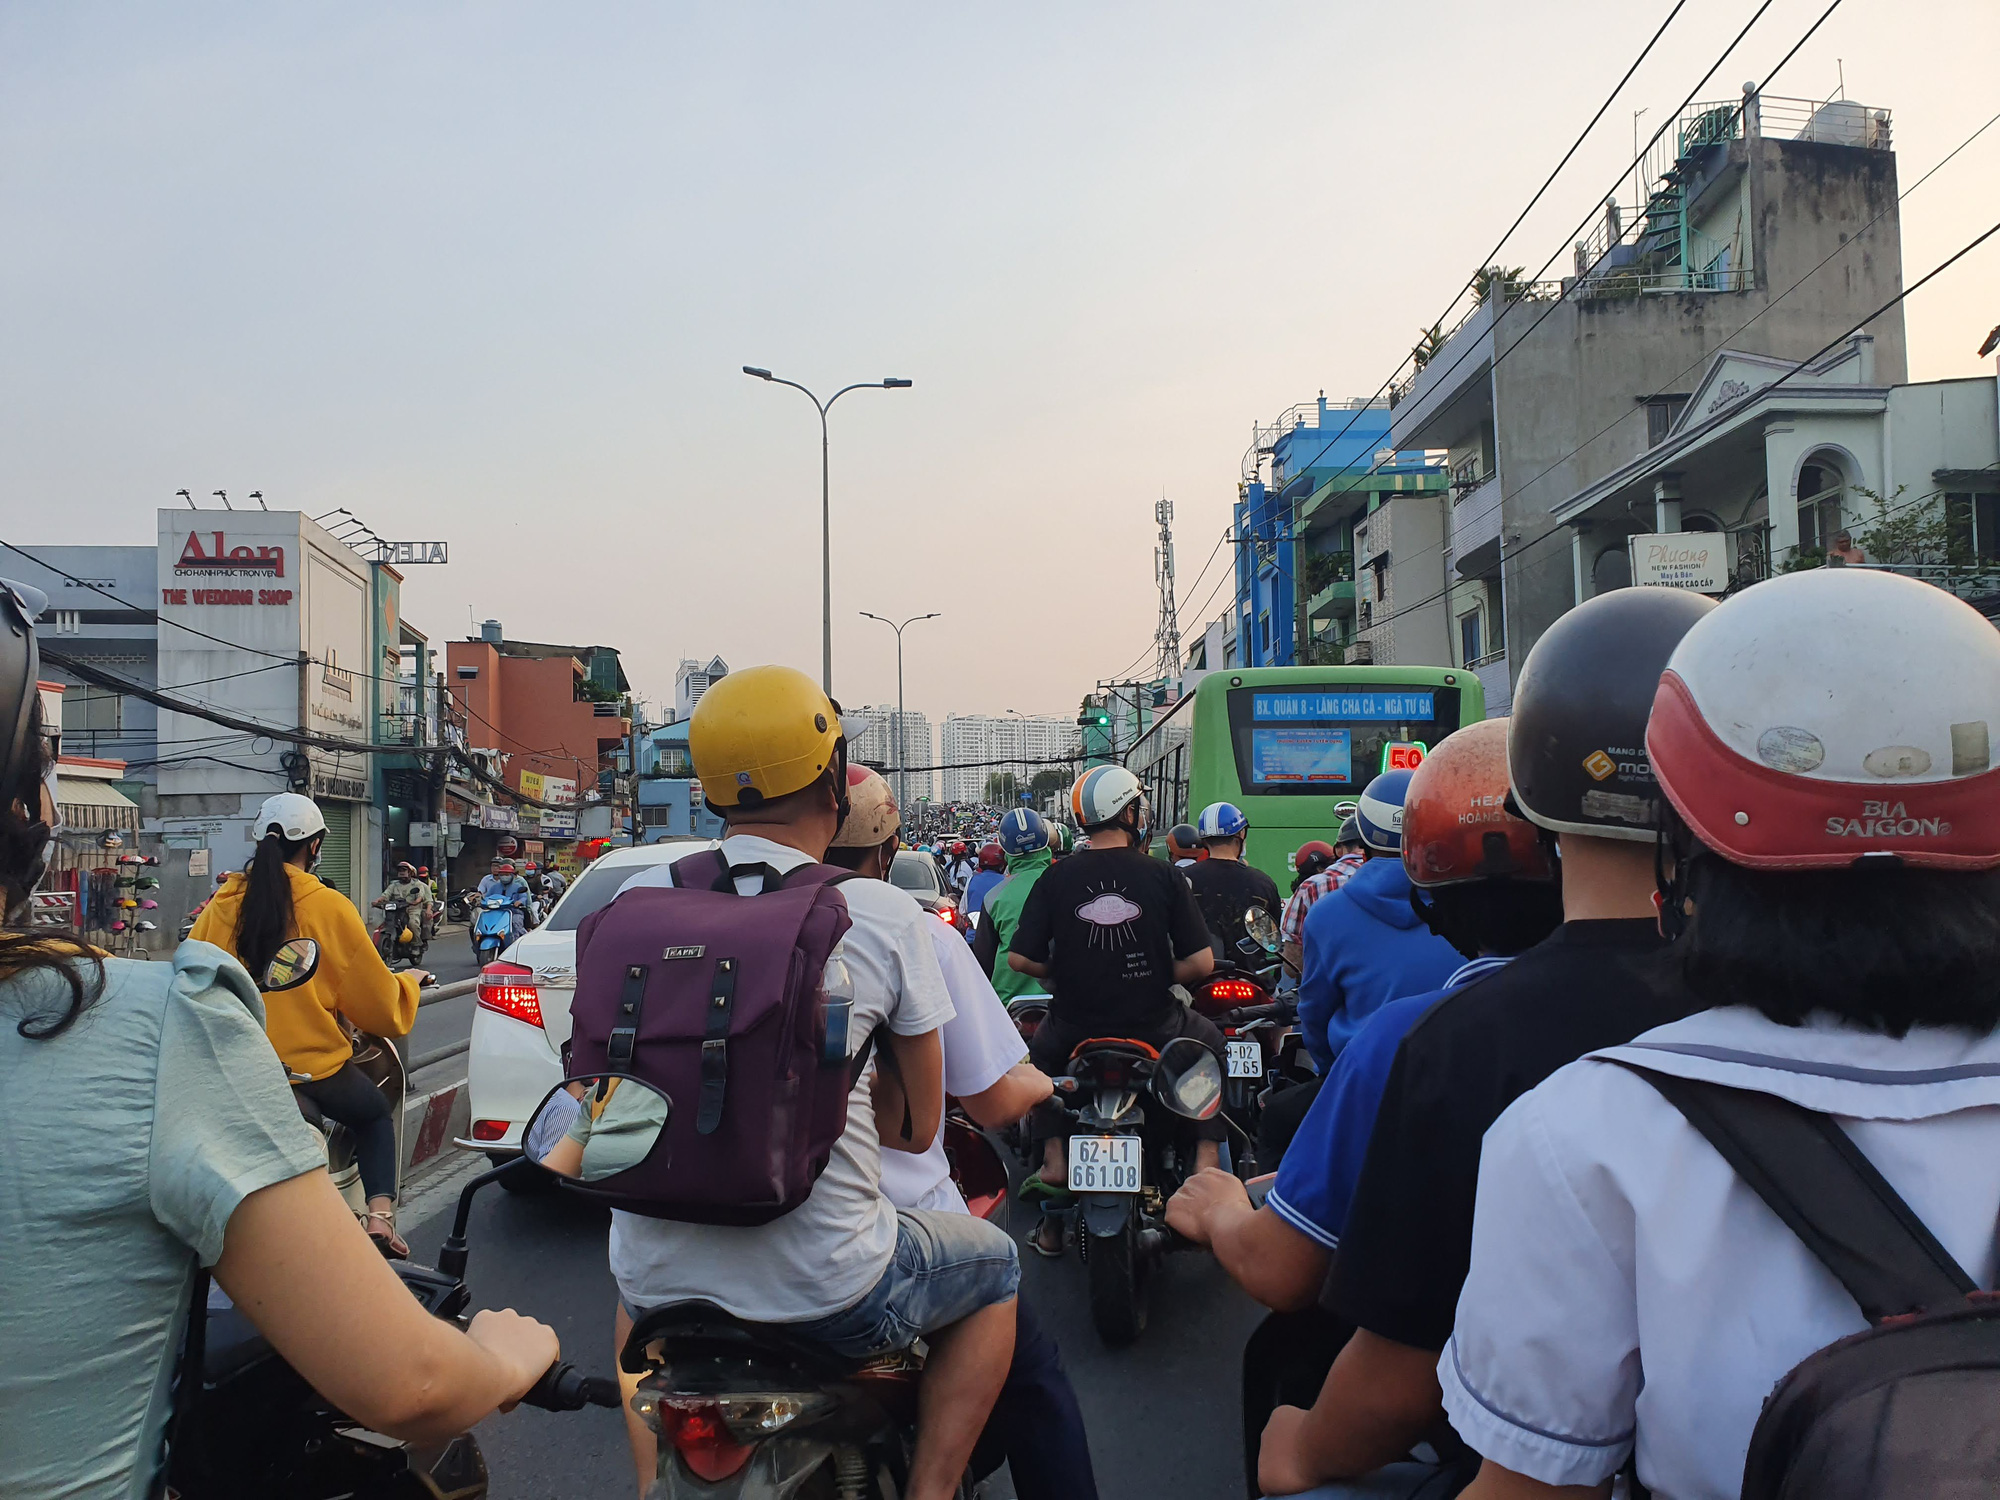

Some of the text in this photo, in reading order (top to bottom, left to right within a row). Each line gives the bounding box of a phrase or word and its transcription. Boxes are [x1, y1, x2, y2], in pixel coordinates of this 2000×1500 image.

[1661, 580, 1684, 588] TRANG
[1685, 580, 1699, 588] CAO
[162, 589, 292, 605] THE WEDDING SHOP
[1256, 700, 1271, 715] BX.
[1273, 696, 1298, 718] QUẬN
[1301, 700, 1306, 714] 8
[1341, 699, 1361, 714] CHA
[1418, 699, 1431, 714] GA
[1618, 762, 1654, 774] mo
[1470, 795, 1504, 808] HEA
[1862, 801, 1907, 818] BIA
[1825, 817, 1941, 837] SAIGON
[1226, 1045, 1253, 1059] 9-D2
[1230, 1060, 1258, 1074] 7.65
[1080, 1140, 1128, 1162] 62-L1
[1073, 1164, 1136, 1187] 661.08
